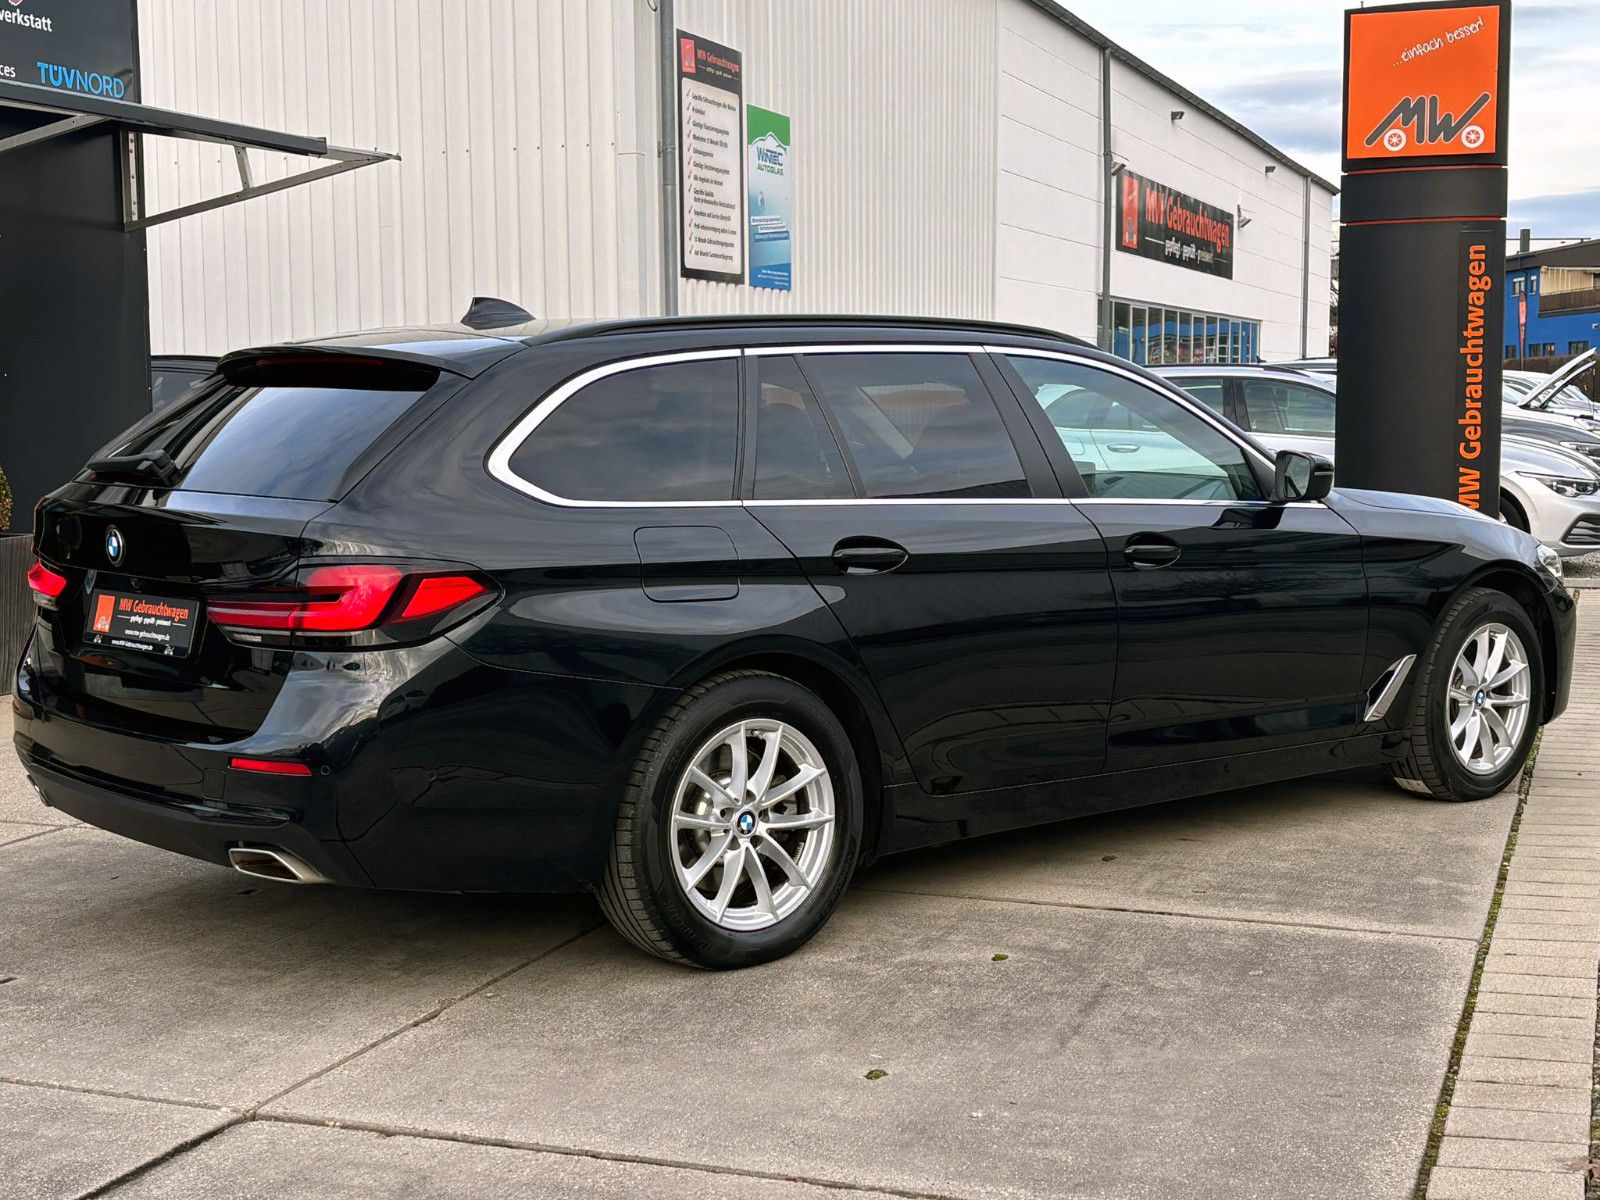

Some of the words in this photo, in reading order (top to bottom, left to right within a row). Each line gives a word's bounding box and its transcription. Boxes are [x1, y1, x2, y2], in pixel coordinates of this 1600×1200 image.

[1445, 16, 1485, 44] besser!
[1364, 92, 1491, 147] MW
[1145, 186, 1165, 225] MW
[1167, 195, 1230, 254] Gebrauchtwagen
[1458, 244, 1492, 460] Gebrauchtwagen
[119, 598, 133, 612] MW
[133, 600, 189, 622] Gebrauchtwagen
